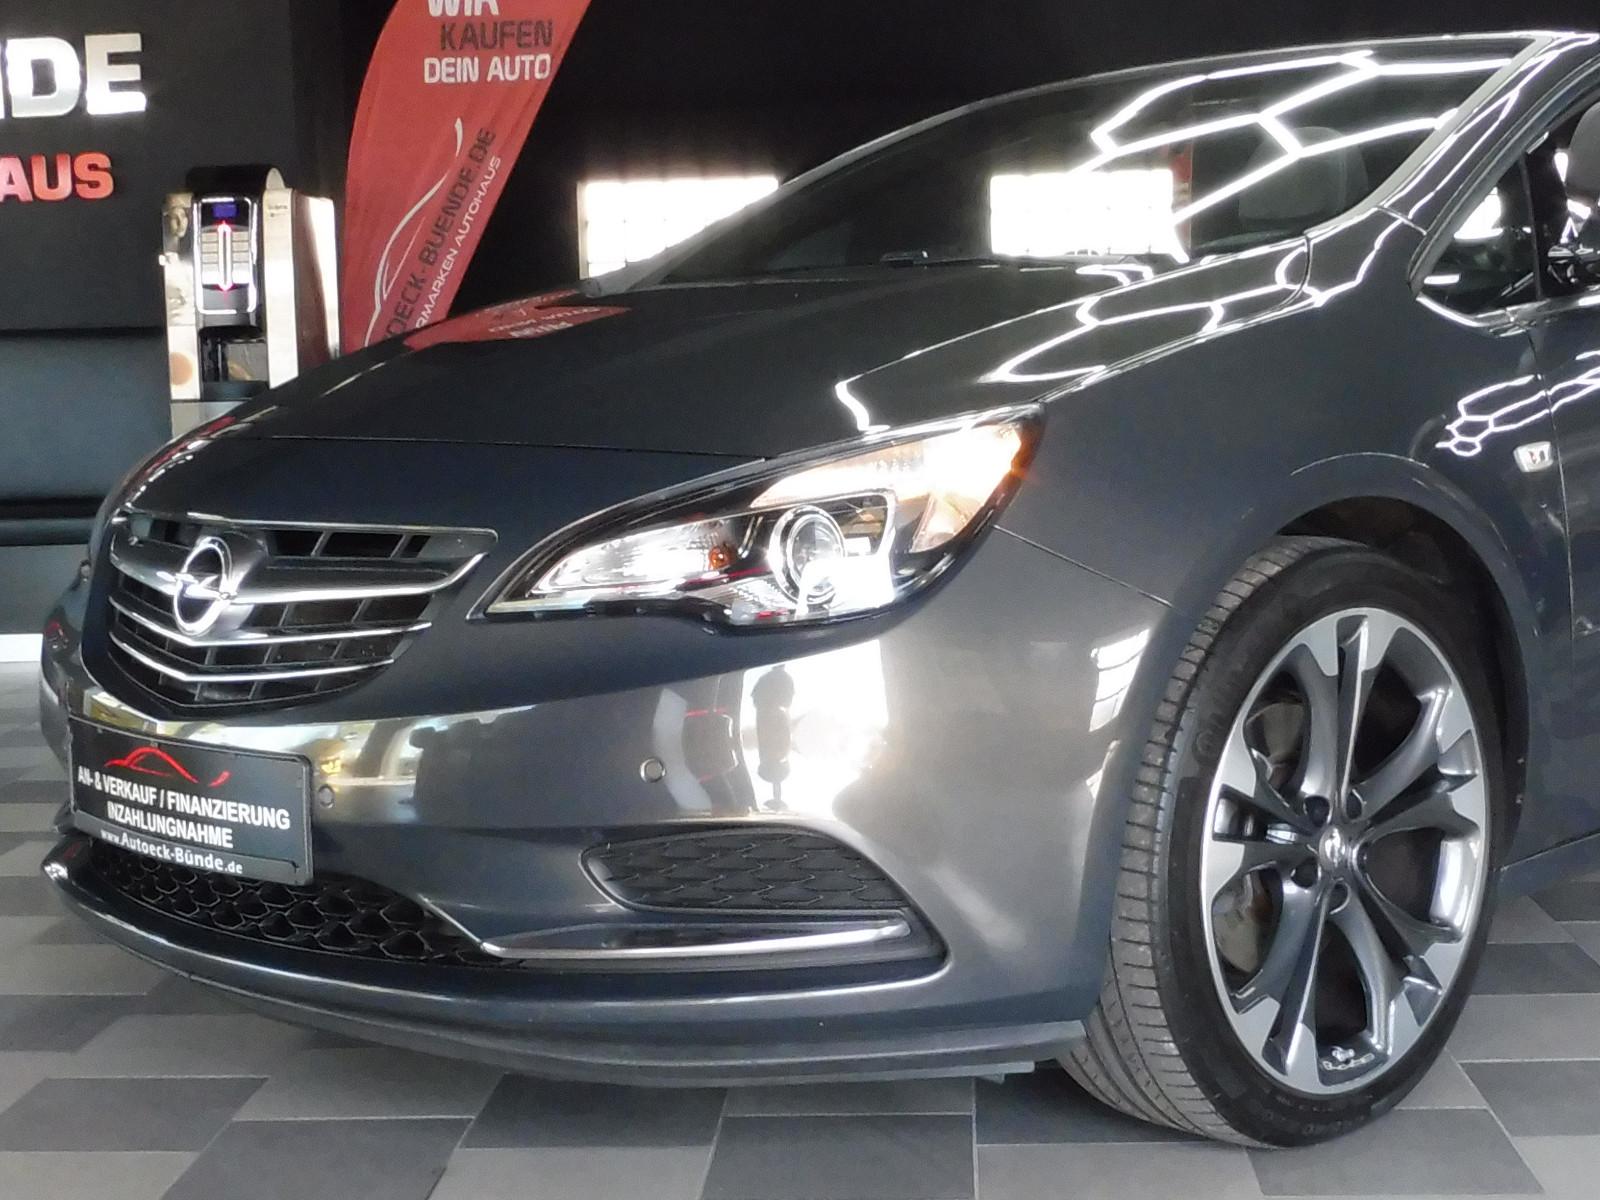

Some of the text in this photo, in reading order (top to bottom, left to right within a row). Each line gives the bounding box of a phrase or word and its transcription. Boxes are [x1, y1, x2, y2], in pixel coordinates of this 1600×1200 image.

[440, 20, 553, 50] KAUFEN
[0, 33, 147, 119] DE
[424, 53, 551, 84] DEIN AUTO
[455, 155, 501, 248] AUTOHAUS
[94, 771, 102, 791] &
[102, 774, 158, 806] VERKAUF
[159, 789, 165, 809] /
[167, 790, 291, 830] FINANZIERUNG
[107, 800, 234, 849] INZAHLUNGNAHME
[100, 828, 244, 875] www.Autoeck-Bünde.de
